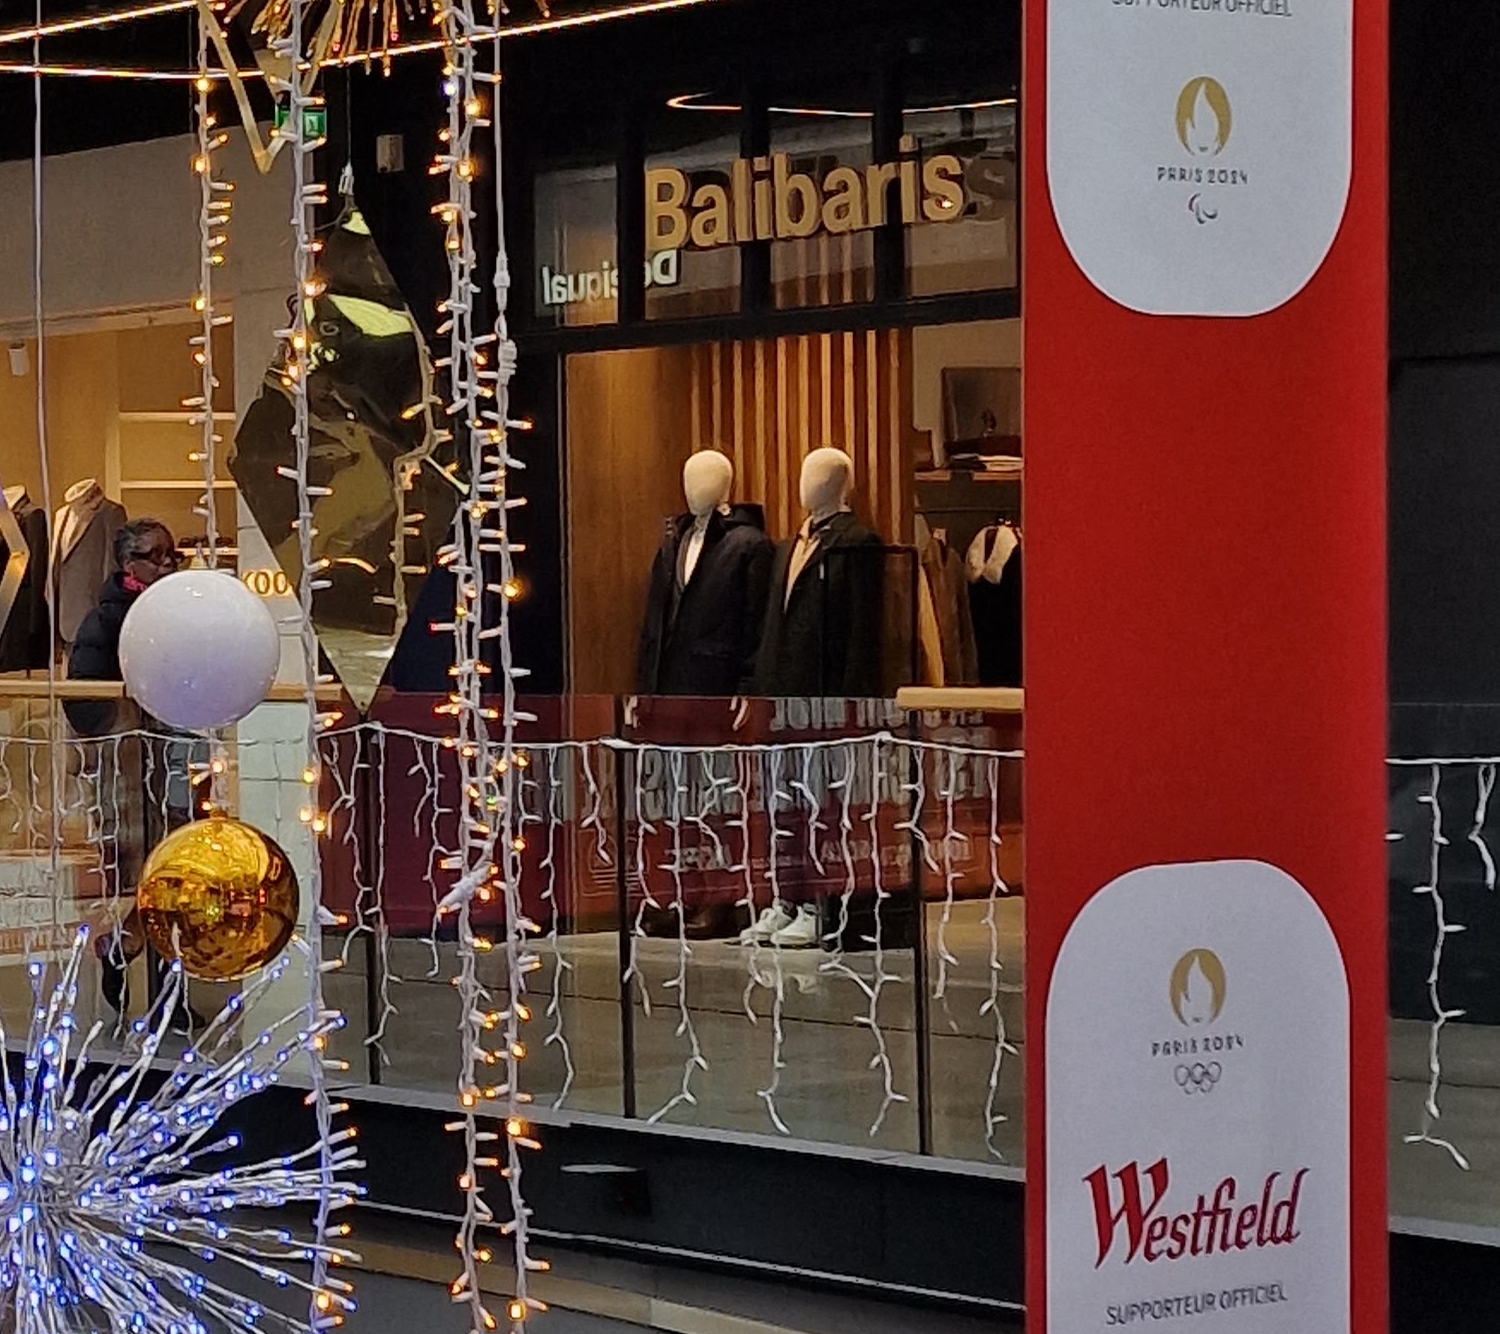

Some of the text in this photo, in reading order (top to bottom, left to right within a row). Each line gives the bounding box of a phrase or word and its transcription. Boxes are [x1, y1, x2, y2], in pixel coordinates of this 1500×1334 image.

[645, 133, 965, 253] Balibaris
[1156, 166, 1249, 185] PARIS 2024
[1081, 1155, 1310, 1270] Westfield
[1105, 1282, 1289, 1327] SUPPORTEUR OFFICIEL
